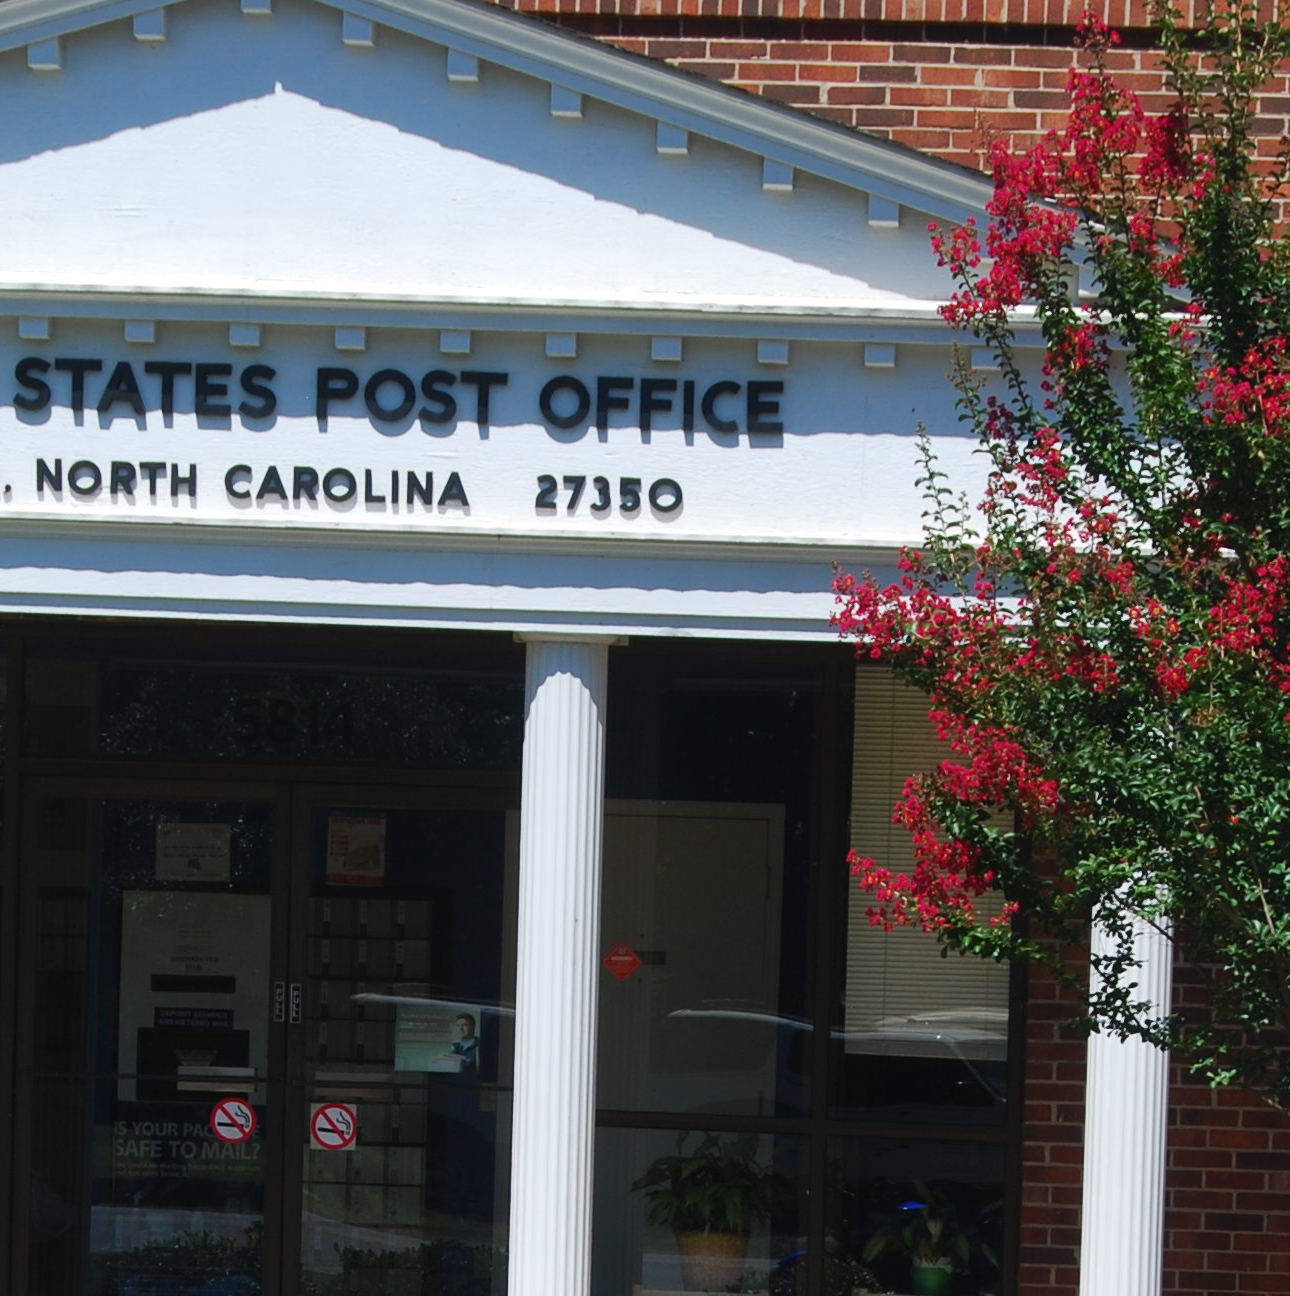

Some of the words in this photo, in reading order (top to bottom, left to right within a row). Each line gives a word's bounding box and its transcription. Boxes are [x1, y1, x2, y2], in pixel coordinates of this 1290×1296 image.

[13, 357, 277, 419] STATES
[316, 366, 508, 428] POST
[539, 375, 784, 436] OFFICE
[36, 458, 197, 498] NORTH
[224, 464, 469, 507] CAROLINA
[535, 474, 683, 513] 27350
[133, 1122, 178, 1136] YOUR
[183, 1123, 260, 1138] PACE
[115, 1139, 161, 1158] SAFE
[169, 1141, 196, 1159] TO
[201, 1142, 261, 1160] MAIL?
